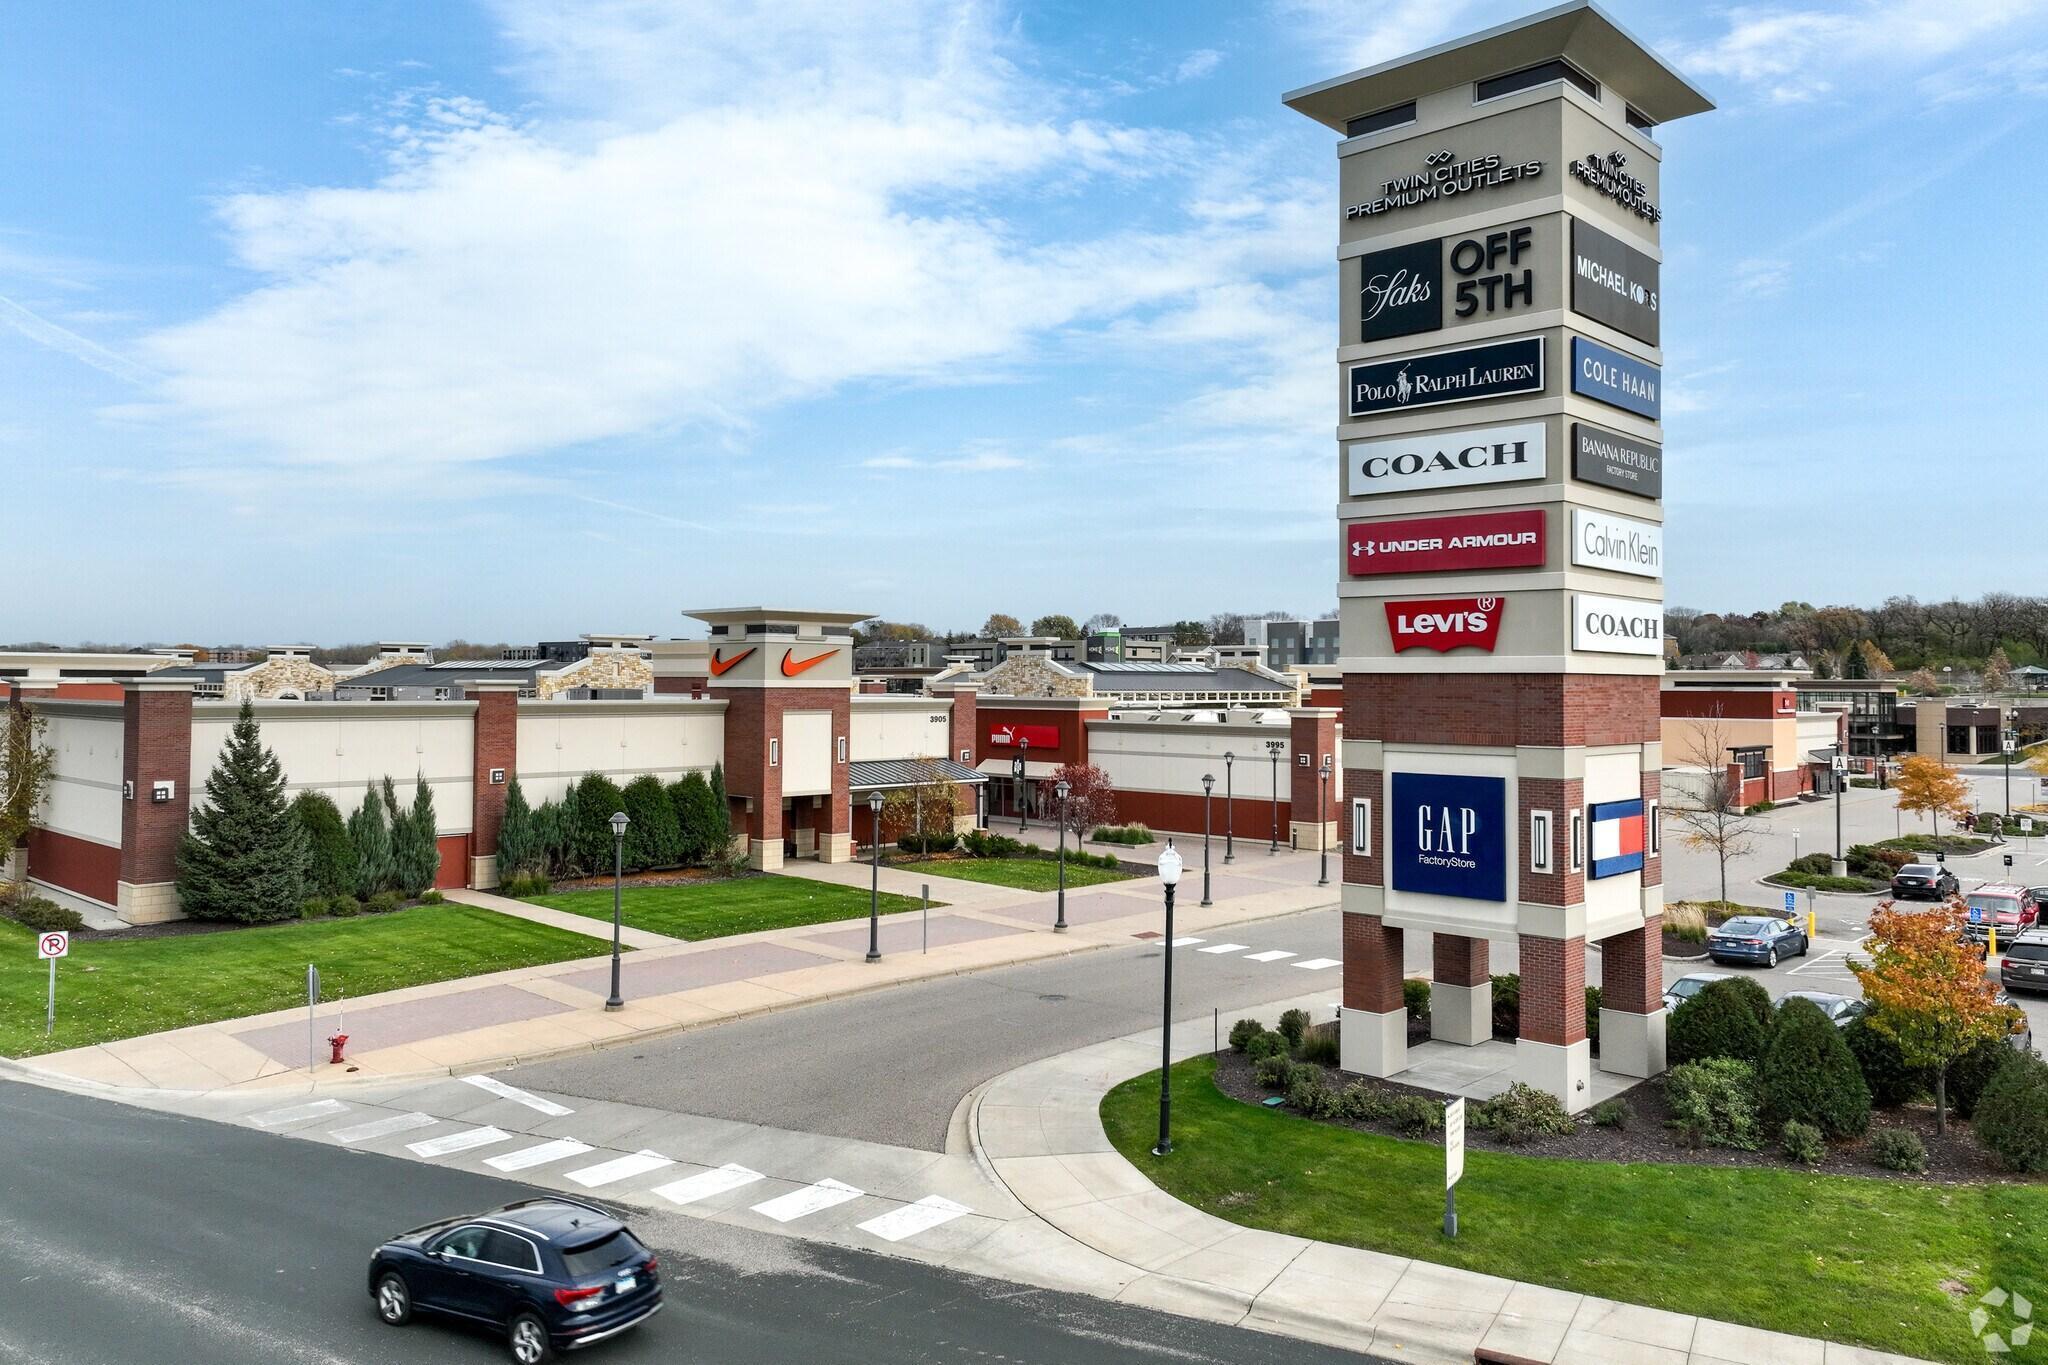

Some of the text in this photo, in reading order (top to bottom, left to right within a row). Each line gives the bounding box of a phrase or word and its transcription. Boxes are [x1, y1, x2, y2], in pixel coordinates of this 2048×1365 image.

[1346, 161, 1542, 220] PREMIUM OUTLETS
[1381, 154, 1500, 195] TWIN CITIES
[1576, 160, 1662, 222] PREMIUM OUTLETS
[1593, 154, 1647, 197] TWIN CITIES
[1450, 226, 1532, 276] OFF
[1361, 268, 1431, 322] Saks
[1455, 268, 1533, 318] 5TH
[1577, 254, 1628, 297] MICHAEL
[1583, 356, 1656, 403] COLE HAAN
[1361, 440, 1529, 479] COACH
[1582, 436, 1659, 473] BANANA REPUBLIC
[1606, 464, 1639, 481] FACTORY STORE
[1379, 531, 1537, 553] UNDER ARMOUR
[1583, 522, 1659, 566] Calvin Klein
[1585, 612, 1659, 640] COACH
[929, 715, 947, 723] 3905
[991, 734, 1011, 743] PUMA
[1265, 741, 1285, 749] 3995
[1836, 757, 1844, 769] A
[2005, 741, 2012, 750] A
[1418, 804, 1476, 855] GAP
[1418, 854, 1476, 869] FactoryStore
